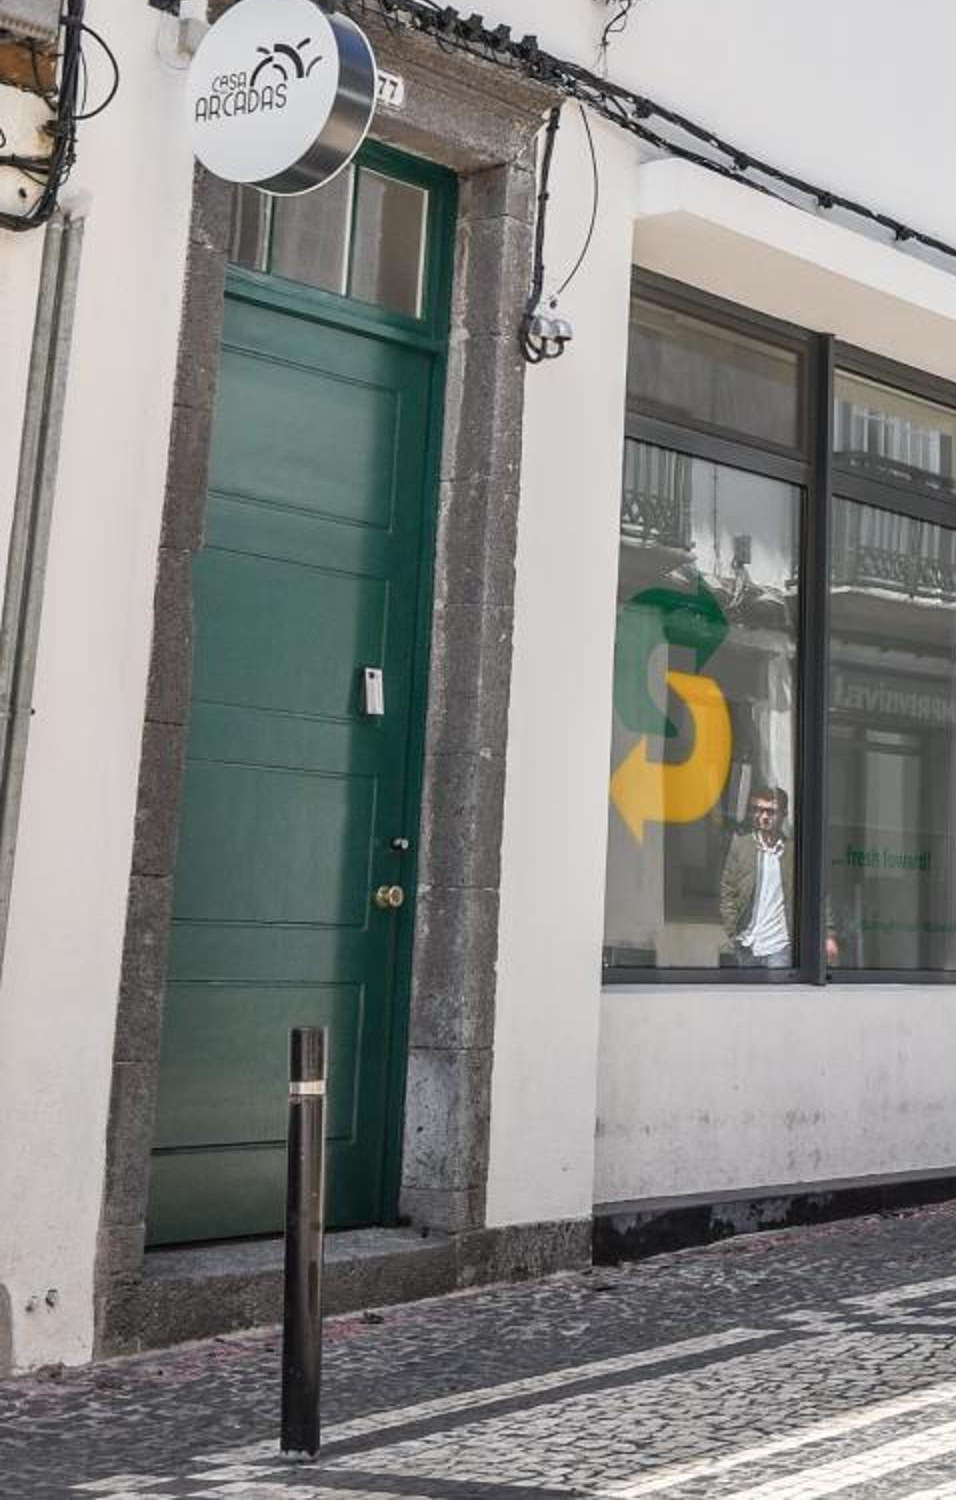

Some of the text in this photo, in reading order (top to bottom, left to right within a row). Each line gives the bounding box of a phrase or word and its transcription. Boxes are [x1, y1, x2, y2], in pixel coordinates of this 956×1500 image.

[211, 72, 248, 93] CASA
[378, 75, 398, 98] 77
[195, 83, 288, 122] ARCADAS
